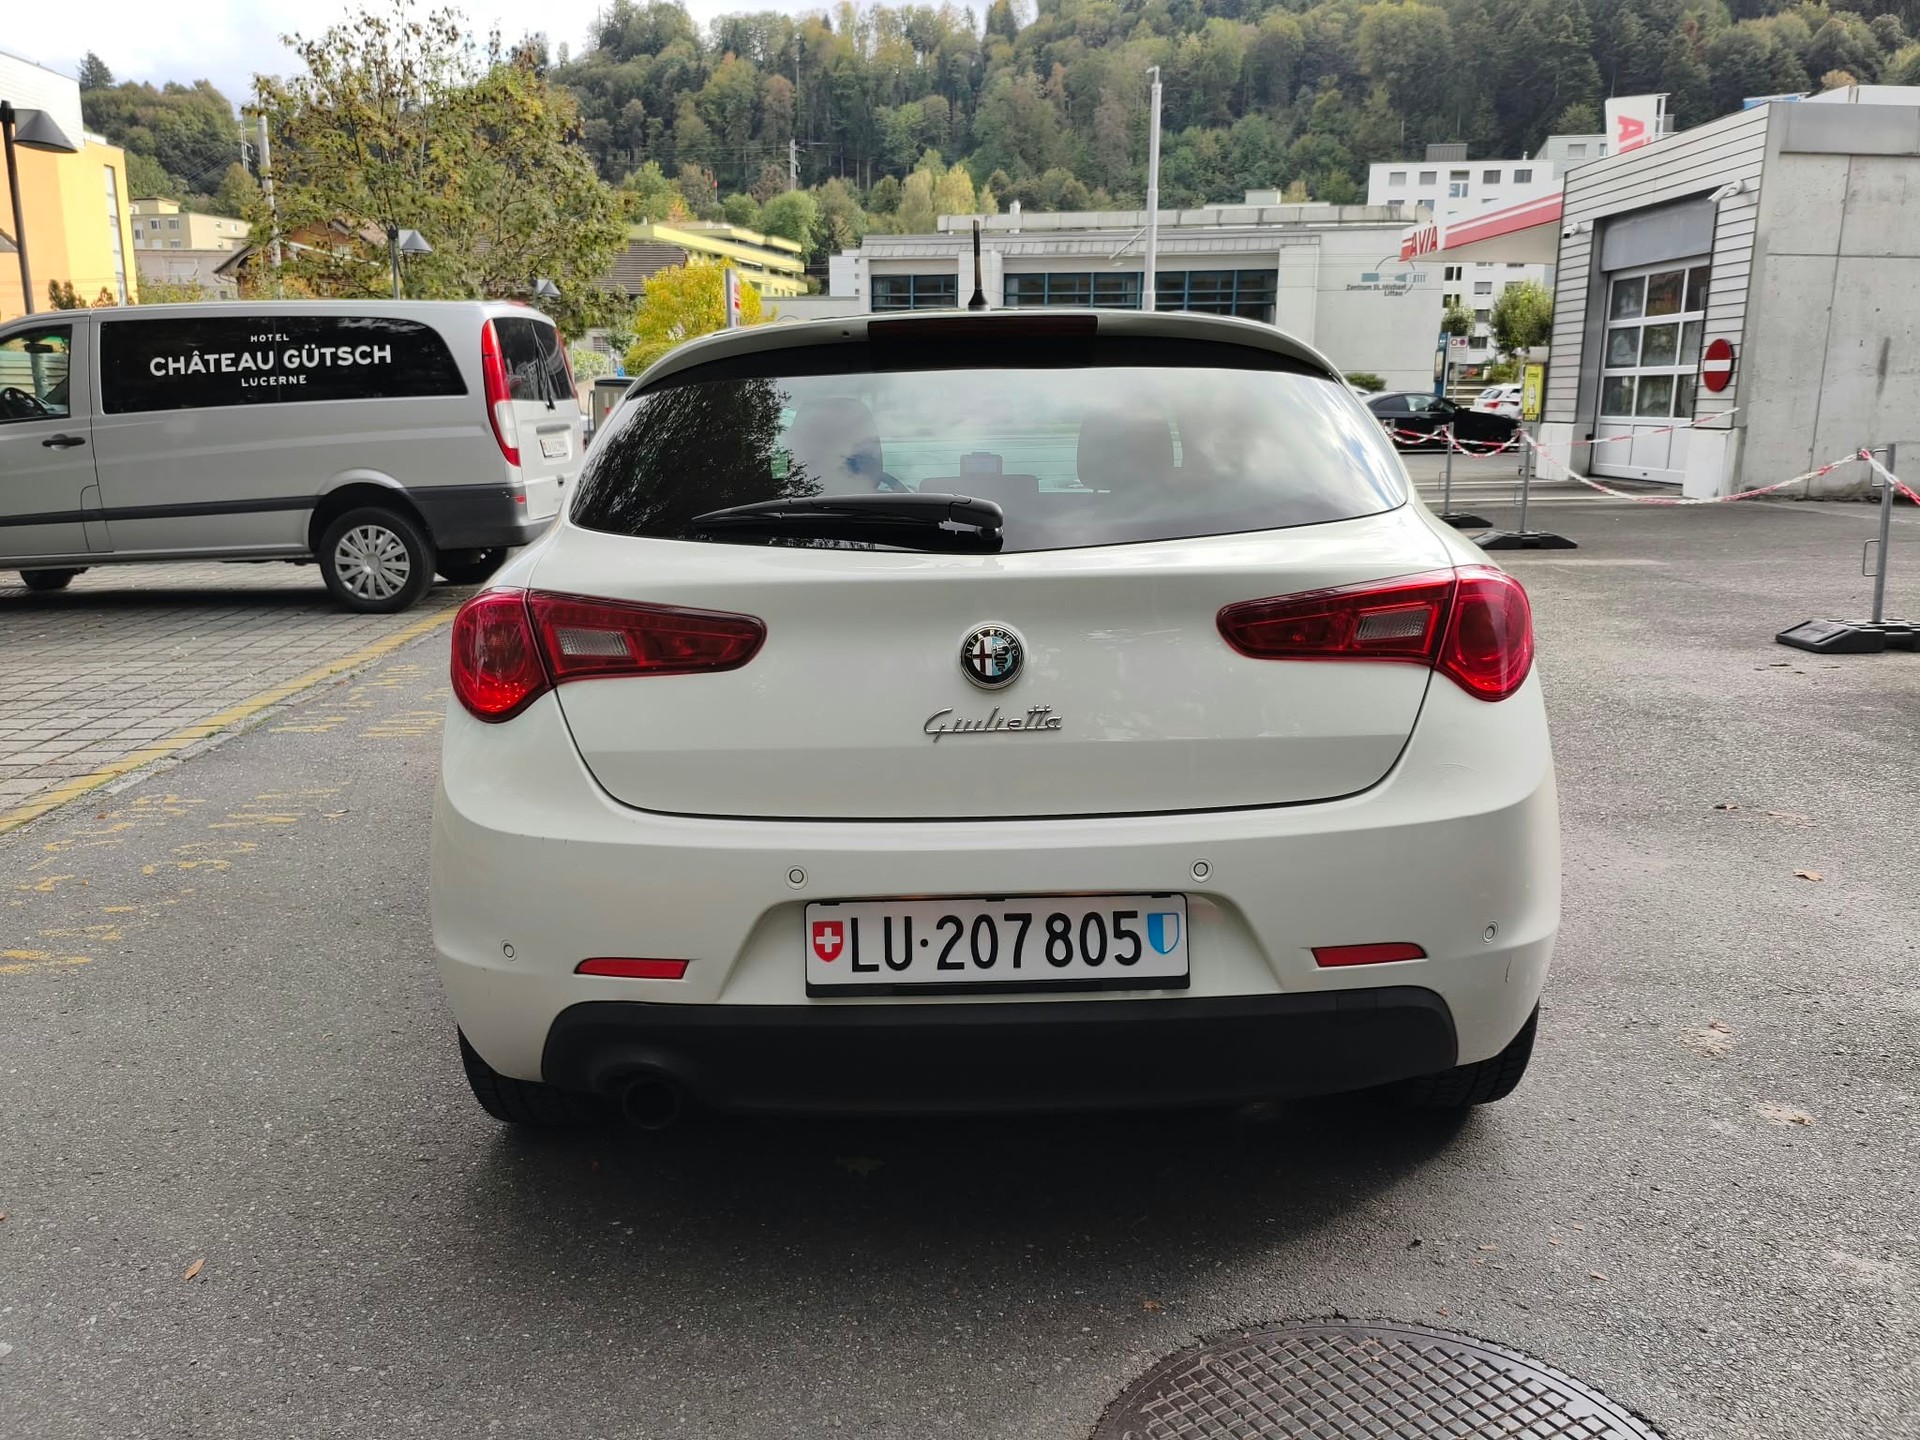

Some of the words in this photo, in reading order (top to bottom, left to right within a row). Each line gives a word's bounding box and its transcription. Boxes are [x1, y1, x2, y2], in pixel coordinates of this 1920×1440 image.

[1409, 225, 1438, 257] AVIA
[250, 333, 290, 343] HOTEL
[149, 350, 274, 377] CHÂTEAU
[282, 344, 392, 369] GÜTSCH
[241, 374, 307, 387] LUCERNE
[965, 633, 985, 659] ALFA
[989, 629, 1019, 657] ROMEO
[923, 704, 1063, 744] Giulietta
